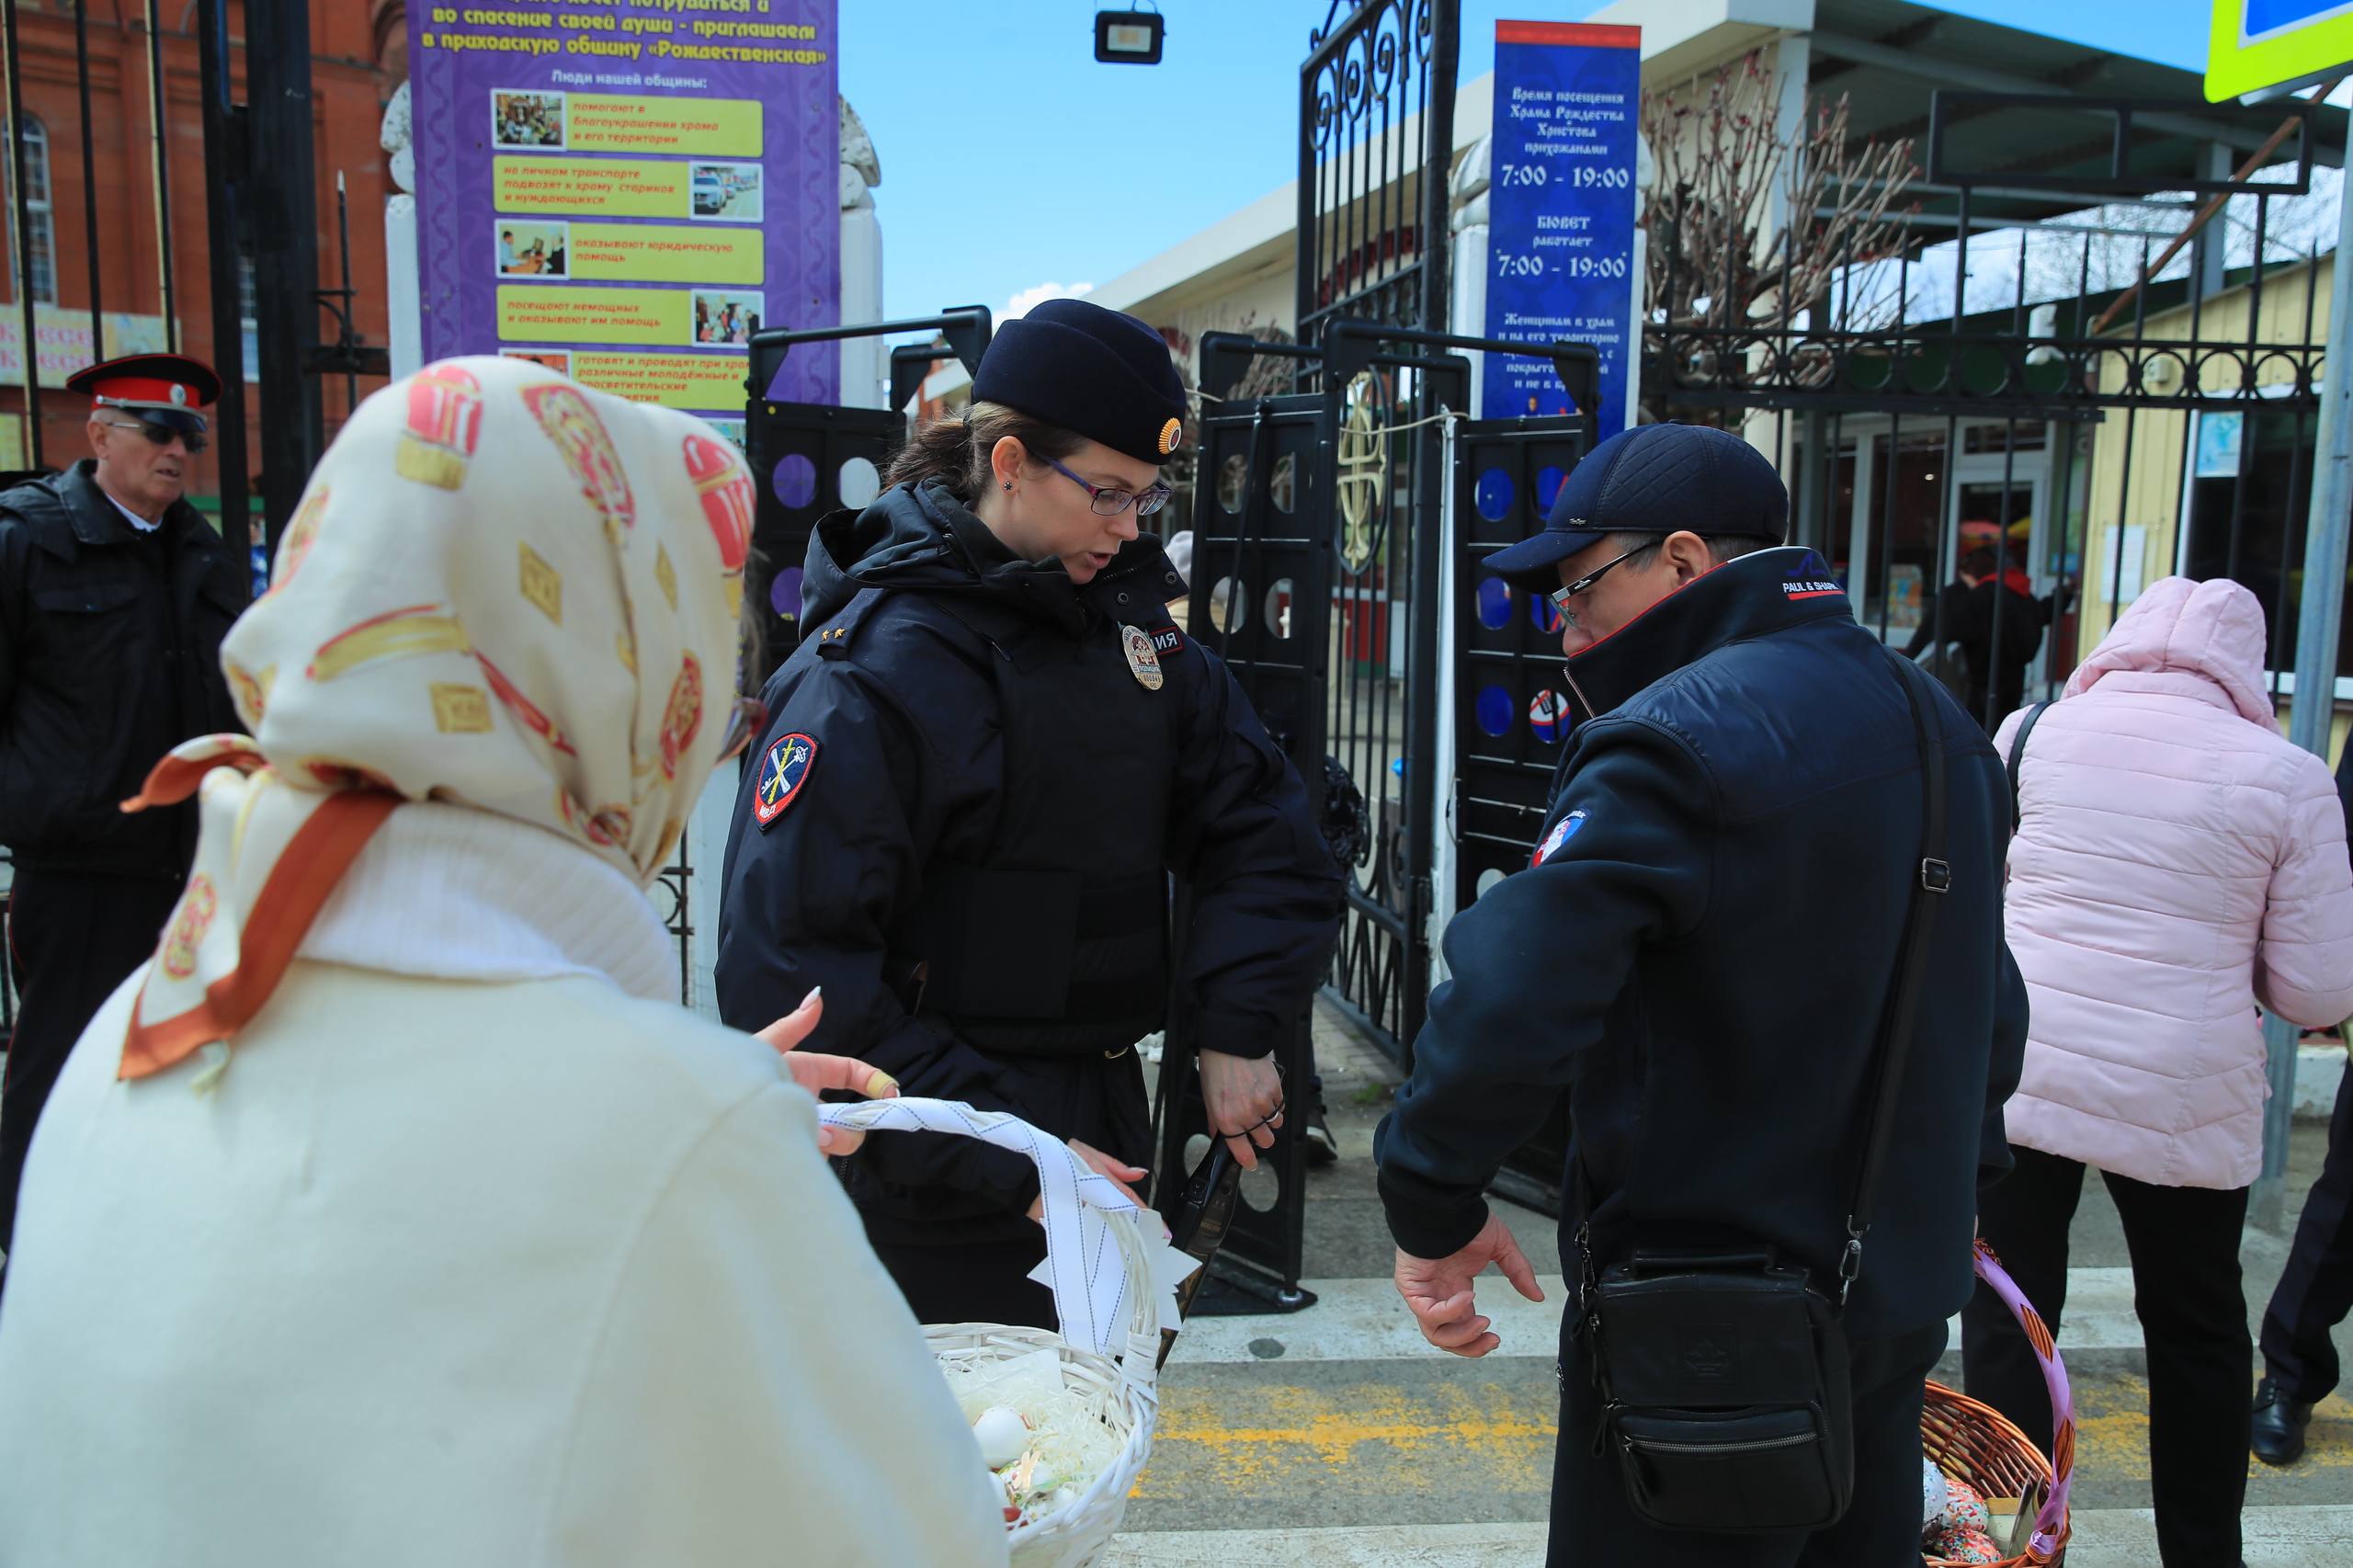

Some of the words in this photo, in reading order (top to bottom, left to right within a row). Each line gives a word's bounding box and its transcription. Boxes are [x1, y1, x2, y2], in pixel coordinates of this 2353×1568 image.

[433, 8, 458, 23] во
[463, 9, 553, 28] спасение
[558, 13, 616, 30] своей
[620, 17, 674, 35] души
[692, 20, 816, 40] приглашаем
[421, 32, 435, 47] в
[441, 33, 561, 56] приходскую
[647, 40, 827, 64] «Рождественская»
[552, 69, 593, 85] Люди
[596, 73, 642, 85] нашей
[644, 73, 708, 89] общины:
[1512, 86, 1552, 105] Время
[1556, 90, 1625, 105] посещения
[573, 102, 634, 113] помогают
[638, 105, 645, 114] в
[1510, 103, 1552, 121] Храма
[1555, 105, 1625, 122] Рождества
[681, 121, 719, 132] храма
[1536, 122, 1597, 139] Христова
[574, 132, 582, 141] и
[585, 132, 605, 142] его
[608, 134, 678, 145] территории
[1524, 142, 1608, 156] прихожанами
[504, 166, 518, 175] на
[522, 167, 568, 176] личном
[572, 168, 641, 180] транспорте
[1501, 164, 1547, 187] 7:00
[1573, 166, 1630, 189] 19:00
[504, 179, 562, 190] подвозят
[576, 184, 613, 194] храму
[619, 185, 676, 195] стариков
[504, 193, 512, 201] и
[515, 193, 605, 205] нуждающихся
[1537, 215, 1591, 230] БЮВЕТ
[575, 239, 644, 249] оказывают
[648, 241, 733, 254] юридическую
[1532, 234, 1593, 249] работает
[575, 253, 626, 263] помощь
[1497, 255, 1544, 278] 7:00
[1569, 256, 1626, 278] 19:00
[507, 301, 570, 312] посещают
[574, 303, 641, 313] немощных
[518, 315, 587, 324] оказывают
[611, 317, 662, 328] помощь
[1505, 312, 1573, 328] Женщинам
[1574, 318, 1583, 327] в
[1586, 318, 1615, 330] храм
[1497, 332, 1506, 340] и
[1509, 333, 1524, 341] на
[1527, 332, 1547, 343] его
[579, 357, 623, 366] готовят
[640, 358, 696, 368] проводят
[699, 359, 722, 369] при
[1506, 363, 1556, 376] покрыто
[579, 368, 644, 379] различные
[1526, 380, 1540, 389] не
[1782, 582, 1806, 593] PAUL
[1806, 581, 1815, 591] &
[759, 803, 777, 818] МВД
